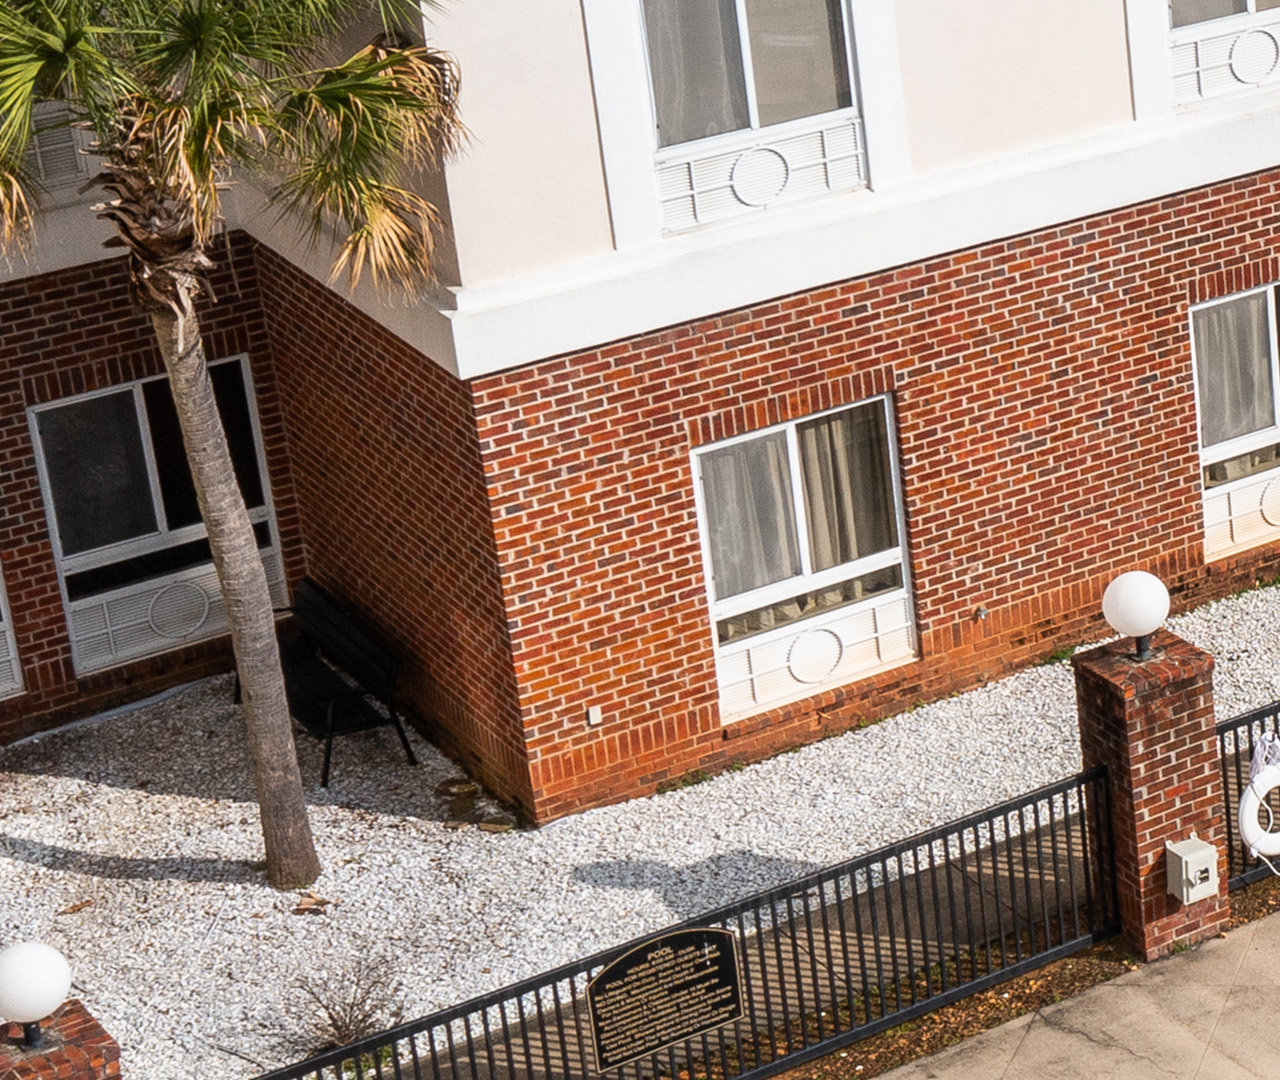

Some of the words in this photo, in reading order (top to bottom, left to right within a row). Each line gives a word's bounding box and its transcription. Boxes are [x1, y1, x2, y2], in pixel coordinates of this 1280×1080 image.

[648, 946, 673, 960] POOL
[606, 980, 623, 990] POOL
[638, 960, 675, 977] REGISTERED
[677, 951, 700, 963] GUESTS
